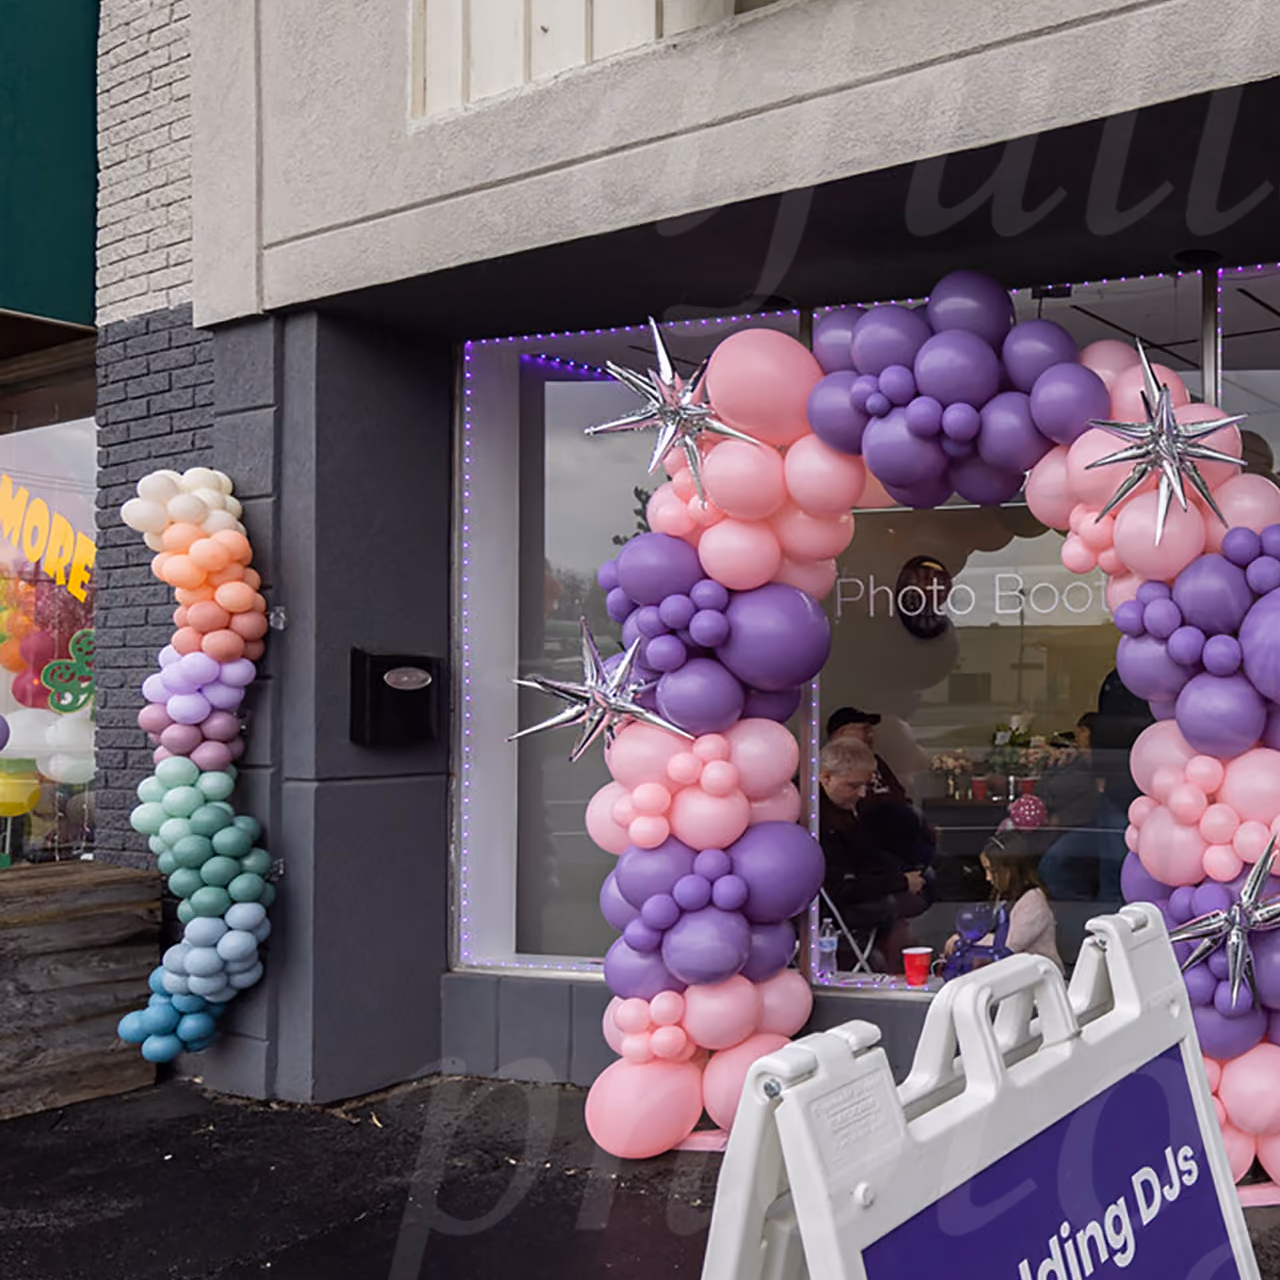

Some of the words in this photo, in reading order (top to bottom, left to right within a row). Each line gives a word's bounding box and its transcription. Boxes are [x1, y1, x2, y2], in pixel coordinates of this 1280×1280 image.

[0, 474, 97, 603] MORE
[835, 575, 976, 618] Photo
[994, 573, 1110, 614] Boot
[1131, 1142, 1200, 1227] DJs
